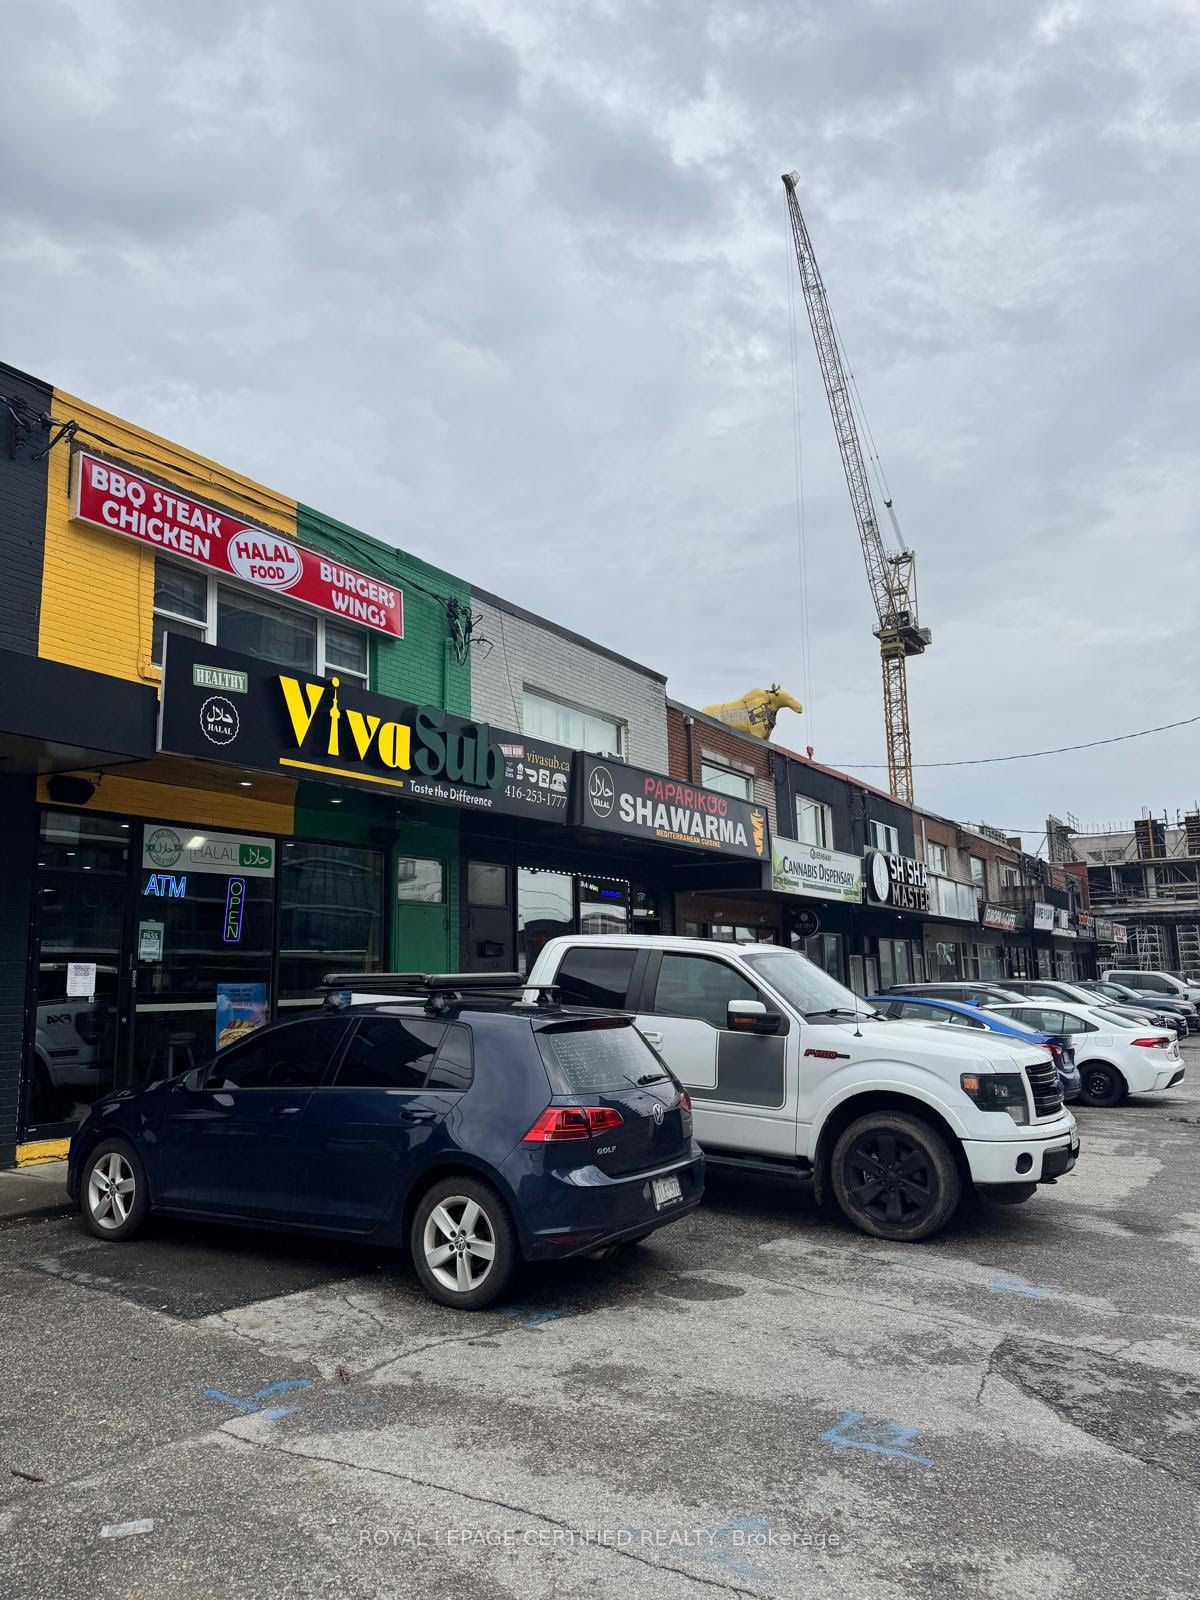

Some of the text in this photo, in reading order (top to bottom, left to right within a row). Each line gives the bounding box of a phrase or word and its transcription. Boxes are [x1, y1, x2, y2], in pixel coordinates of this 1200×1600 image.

[90, 464, 222, 539] BBQ STEAK
[102, 501, 211, 560] CHICKEN
[235, 540, 295, 564] HALAL
[250, 564, 285, 580] FOOD
[320, 561, 396, 609] BURGERS
[332, 590, 387, 628] WINGS
[196, 669, 245, 690] HEALTHY
[206, 705, 233, 724] حلال
[207, 723, 233, 735] HALAL
[527, 750, 570, 772] vivasub.ca
[410, 780, 493, 807] Taste the Difference
[504, 785, 567, 809] 416-253-1777
[590, 773, 613, 797] حلال
[593, 797, 610, 809] HALAL
[619, 793, 748, 847] SHAWARMA
[656, 828, 721, 848] MEDITERRANEAN CUISINE
[193, 845, 237, 861] HALAL
[243, 848, 269, 865] حلال
[144, 873, 187, 898] ATM
[892, 882, 930, 911] MASTER
[226, 881, 243, 939] OPEN
[143, 932, 159, 940] PASS
[597, 1145, 617, 1155] GOLF
